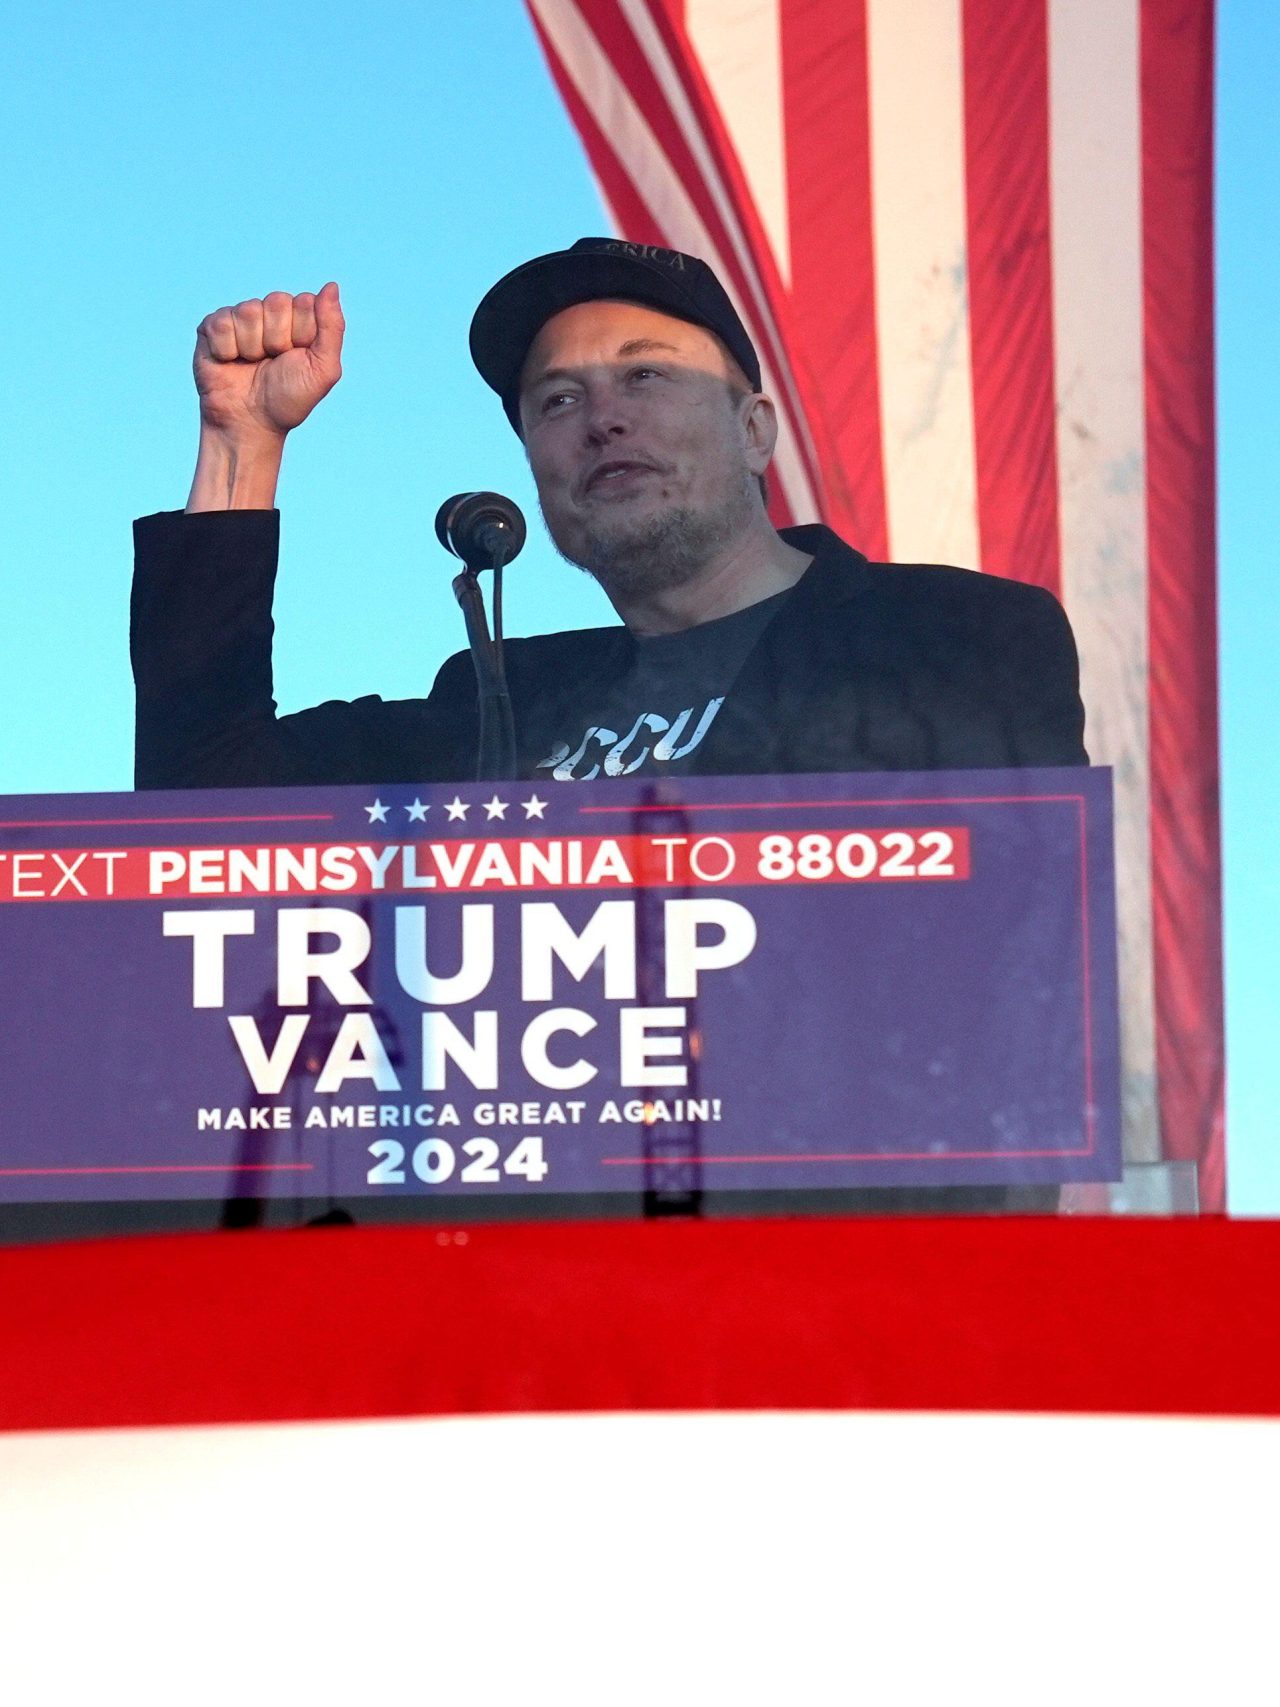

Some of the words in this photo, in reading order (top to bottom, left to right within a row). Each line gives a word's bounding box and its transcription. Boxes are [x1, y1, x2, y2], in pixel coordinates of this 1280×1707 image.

[149, 839, 634, 894] PENNSYLVANIA
[651, 836, 736, 882] TO
[757, 831, 954, 880] 88022
[162, 898, 757, 1009] TRUMP
[228, 1006, 688, 1094] VANCE
[197, 1106, 292, 1130] MAKE
[304, 1103, 461, 1129] AMERICA
[473, 1101, 587, 1126] GREAT
[598, 1098, 722, 1124] AGAIN!
[366, 1136, 548, 1185] 2024
